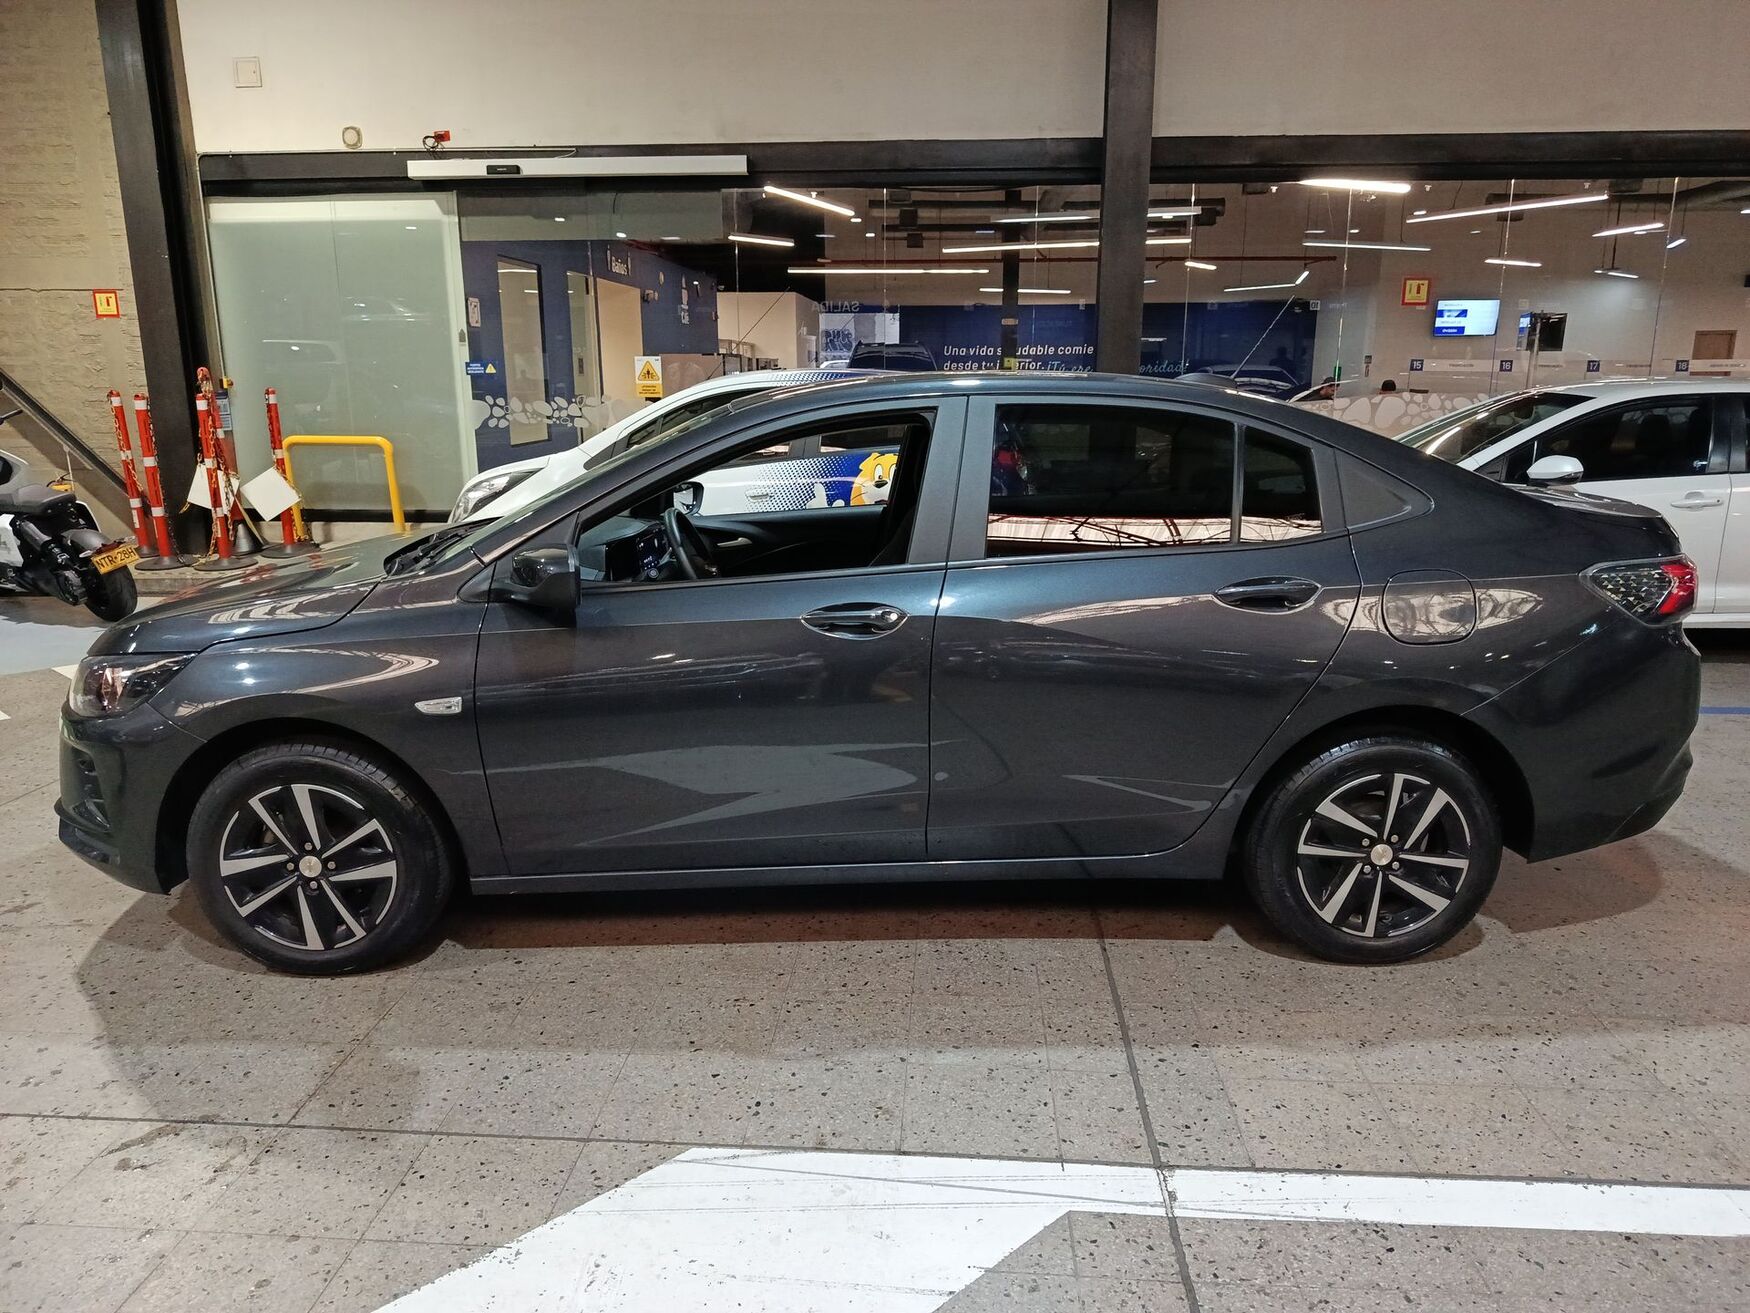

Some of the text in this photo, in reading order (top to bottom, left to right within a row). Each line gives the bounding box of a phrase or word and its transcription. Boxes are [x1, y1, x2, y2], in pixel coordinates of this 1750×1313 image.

[944, 345, 967, 356] Una
[969, 345, 994, 356] vida
[997, 344, 1055, 356] sudable
[943, 360, 979, 371] desde
[1412, 360, 1422, 370] 15
[1502, 360, 1512, 370] 16
[1588, 361, 1599, 371] 17
[1678, 360, 1688, 371] 18
